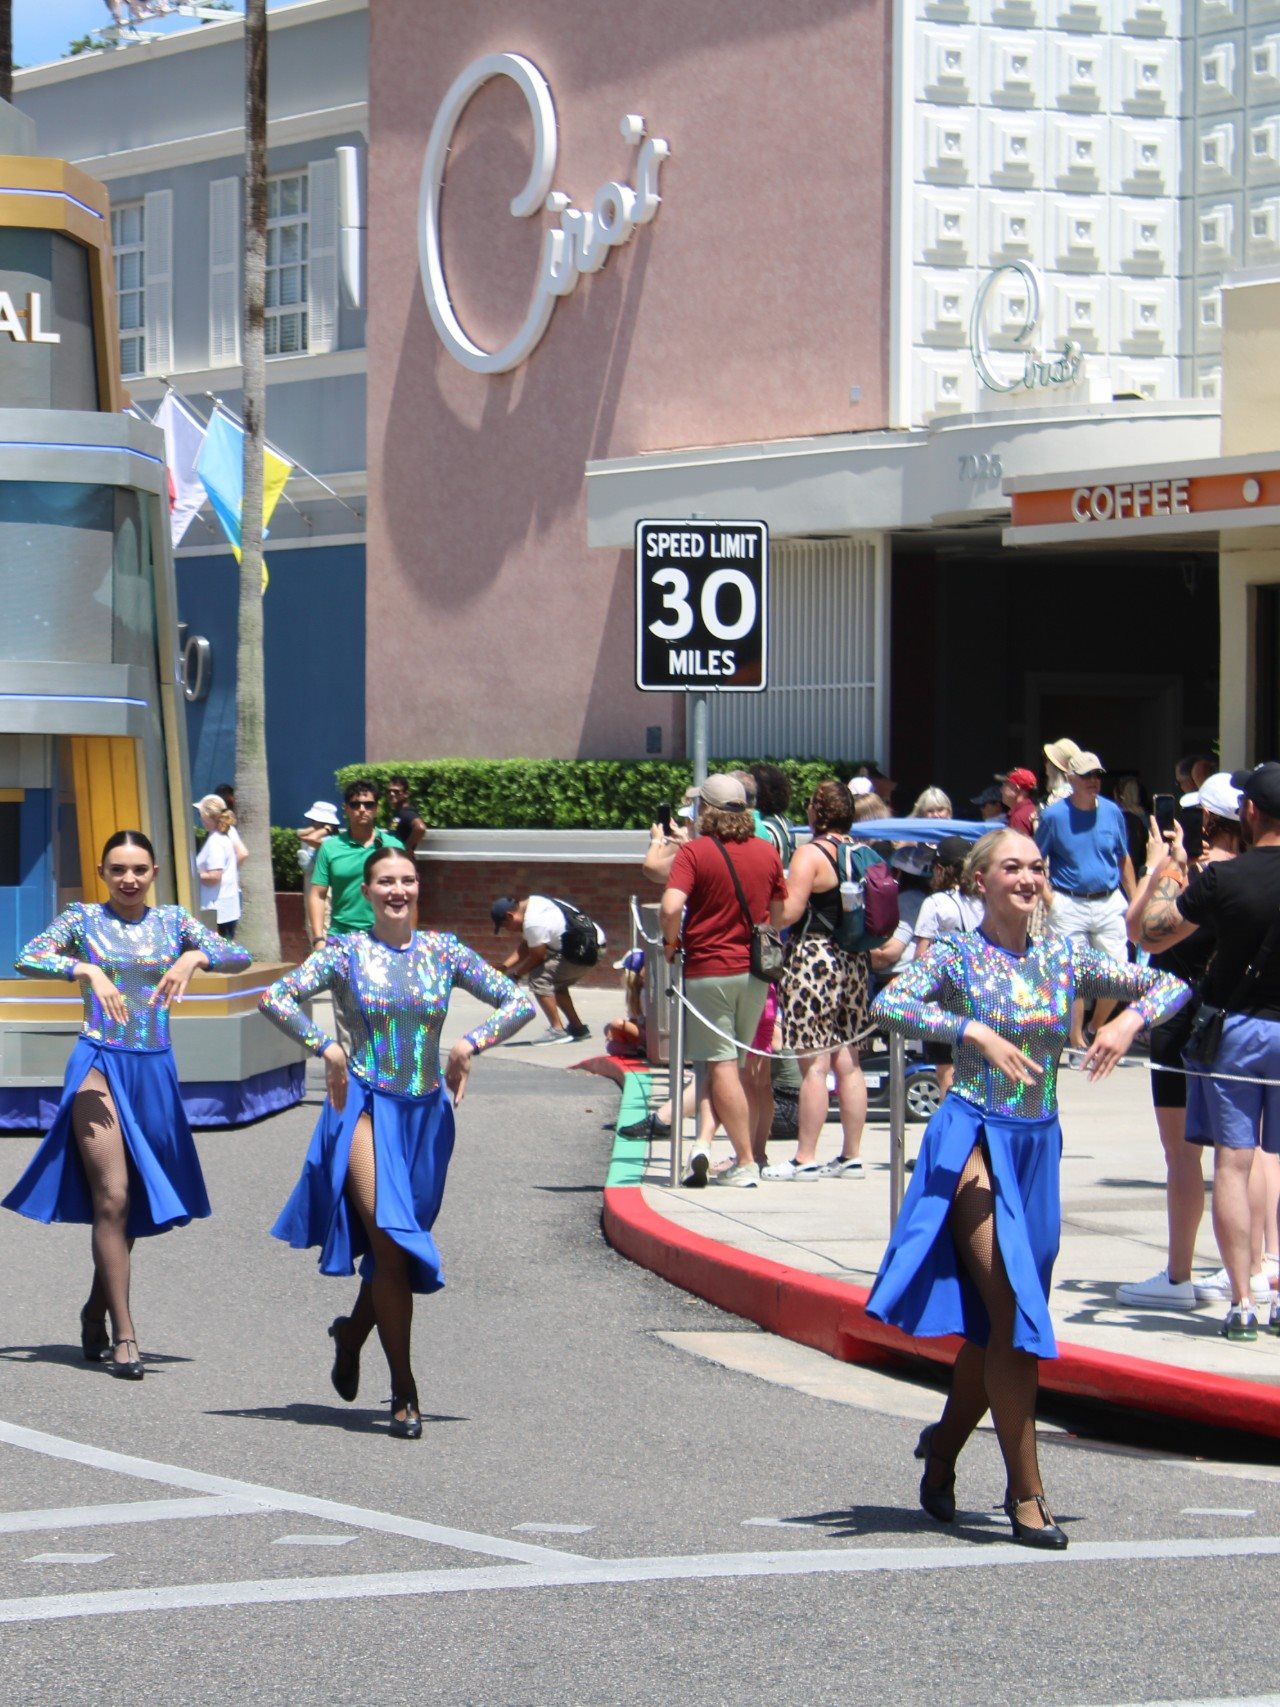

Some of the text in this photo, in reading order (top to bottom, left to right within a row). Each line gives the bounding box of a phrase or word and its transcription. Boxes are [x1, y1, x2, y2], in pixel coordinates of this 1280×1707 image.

[417, 53, 670, 374] Ciro's
[1071, 479, 1190, 523] COFFEE
[646, 533, 758, 558] SPEED LIMIT
[648, 567, 757, 641] 30
[668, 650, 736, 675] MILES
